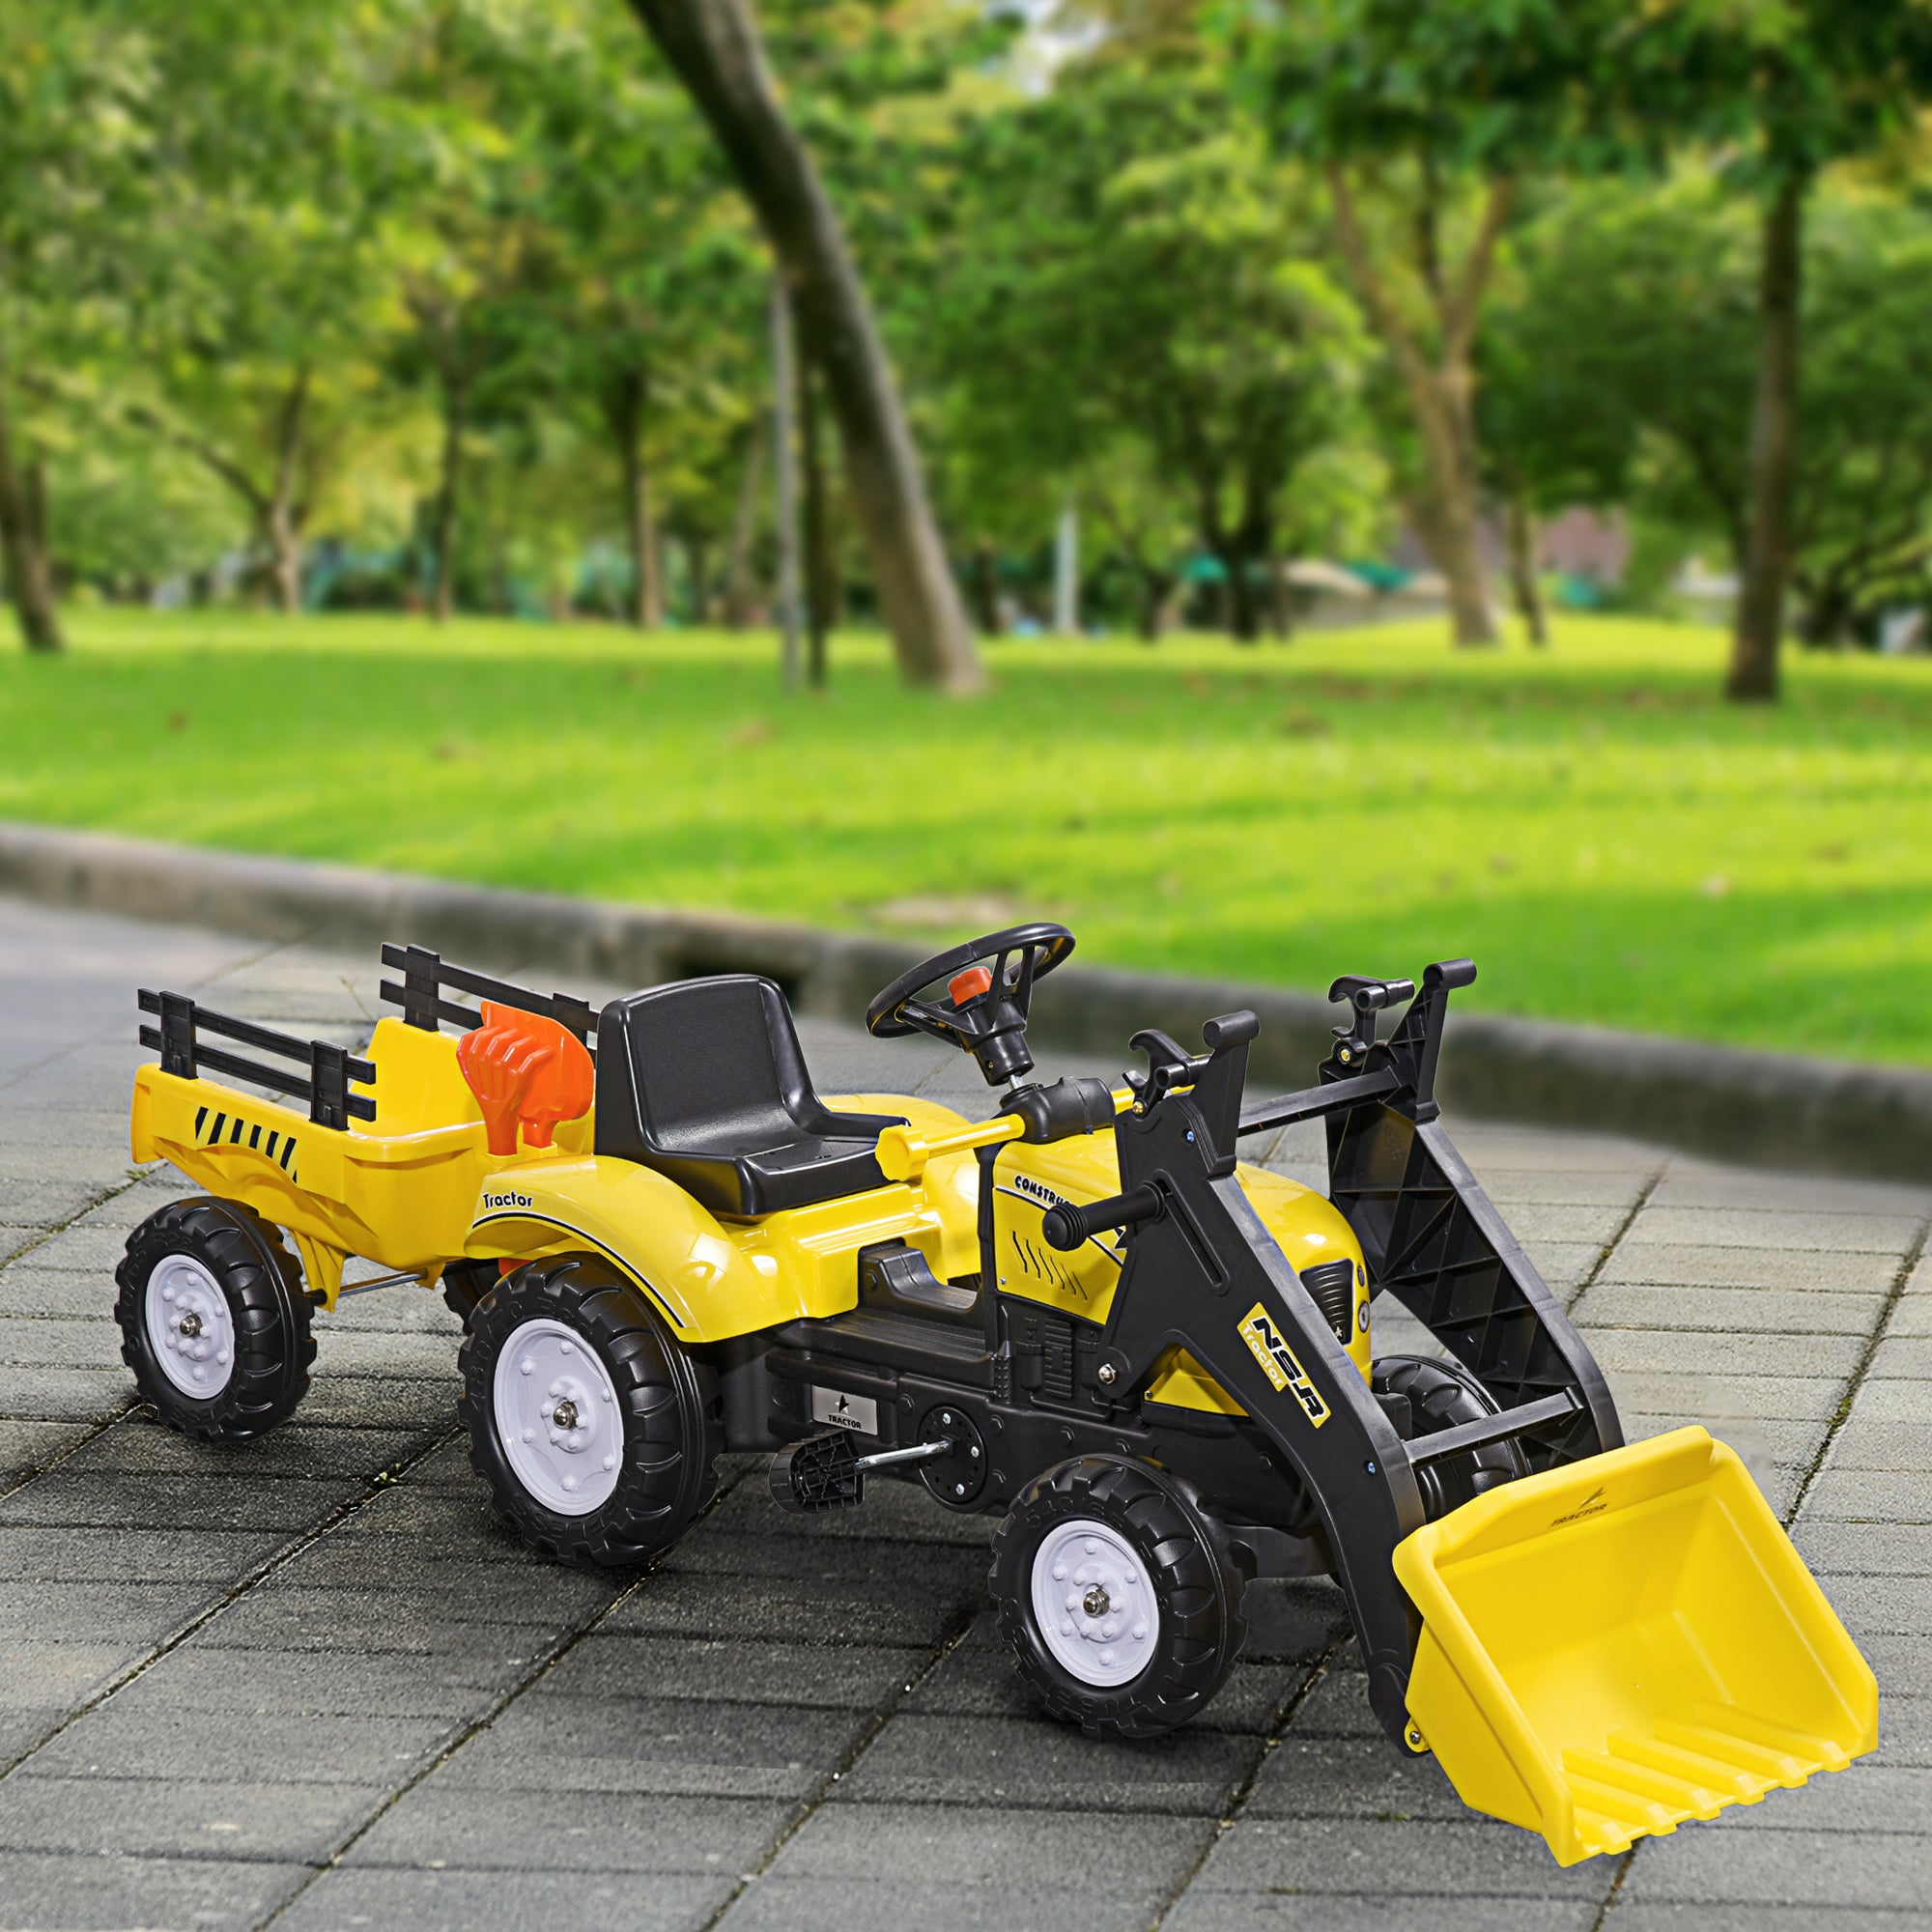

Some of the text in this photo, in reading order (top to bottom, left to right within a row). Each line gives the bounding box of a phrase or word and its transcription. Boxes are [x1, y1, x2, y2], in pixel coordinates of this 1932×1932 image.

[483, 1190, 533, 1209] Tractor
[1242, 1321, 1284, 1385] Tractor
[827, 1414, 863, 1430] TRACTOR
